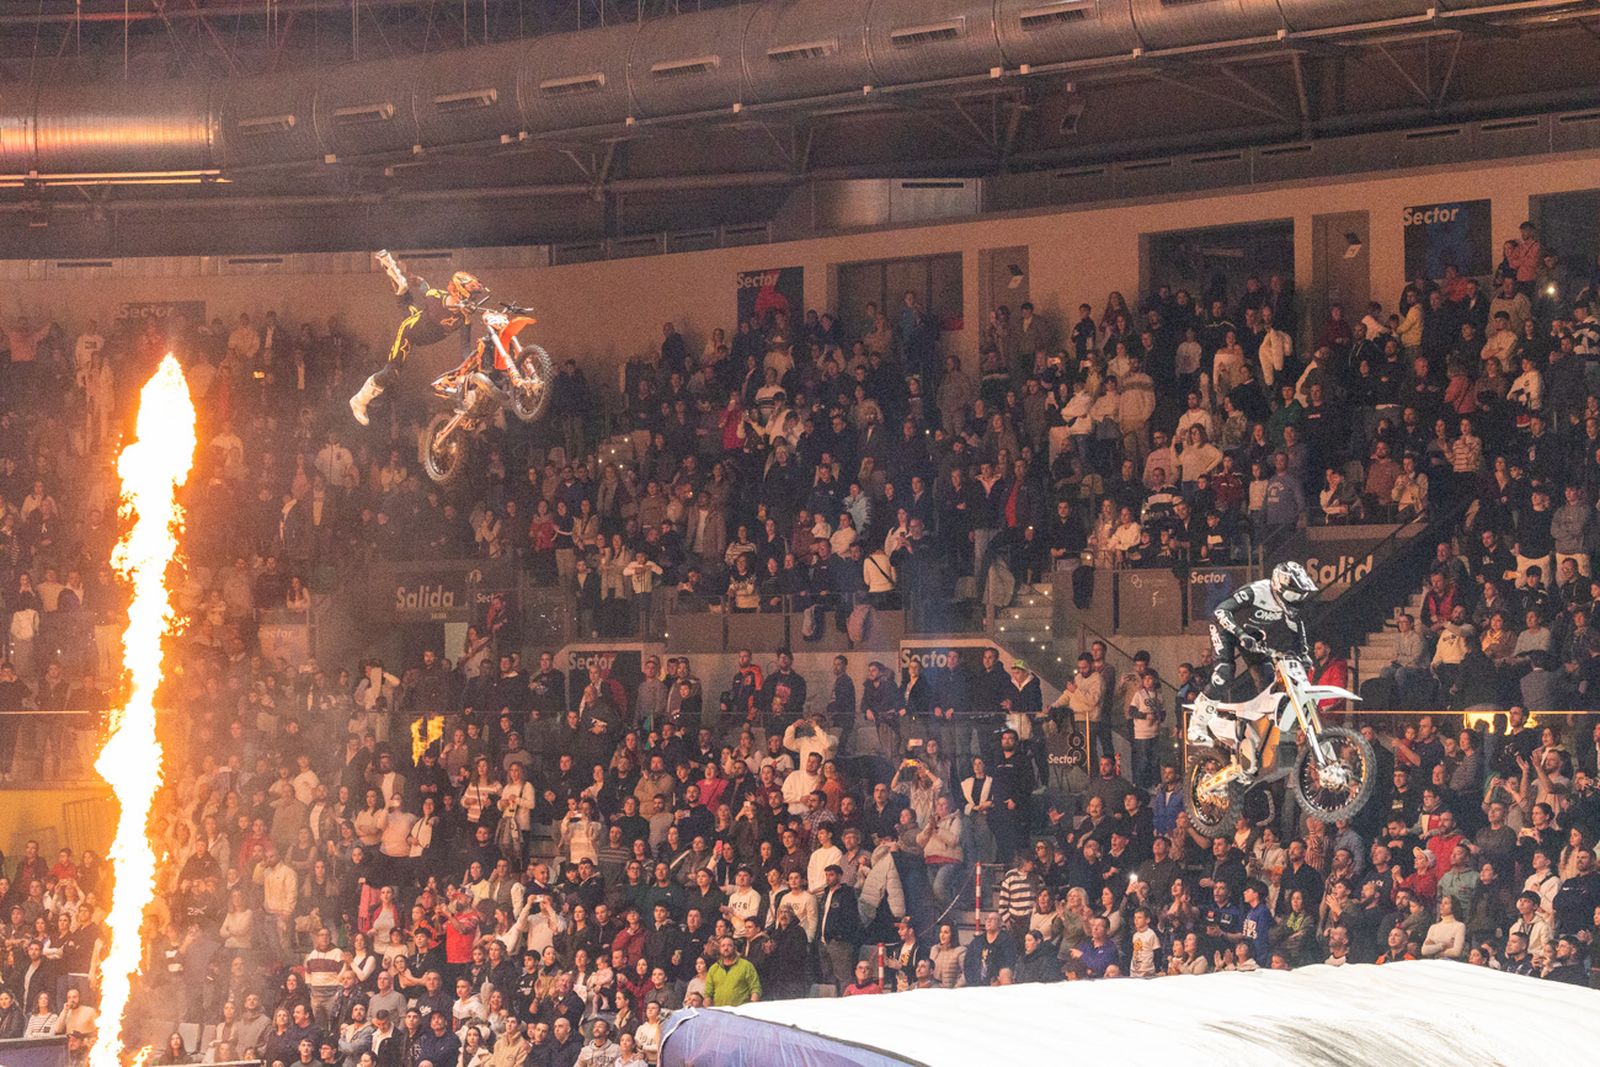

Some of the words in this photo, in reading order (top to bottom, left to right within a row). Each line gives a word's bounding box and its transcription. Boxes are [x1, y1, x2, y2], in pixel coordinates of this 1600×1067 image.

[1403, 207, 1459, 226] Sector
[736, 272, 780, 289] Sector
[1190, 571, 1226, 584] Sector
[1306, 554, 1374, 586] Salid
[396, 585, 454, 608] Salida
[1048, 753, 1077, 764] Sector
